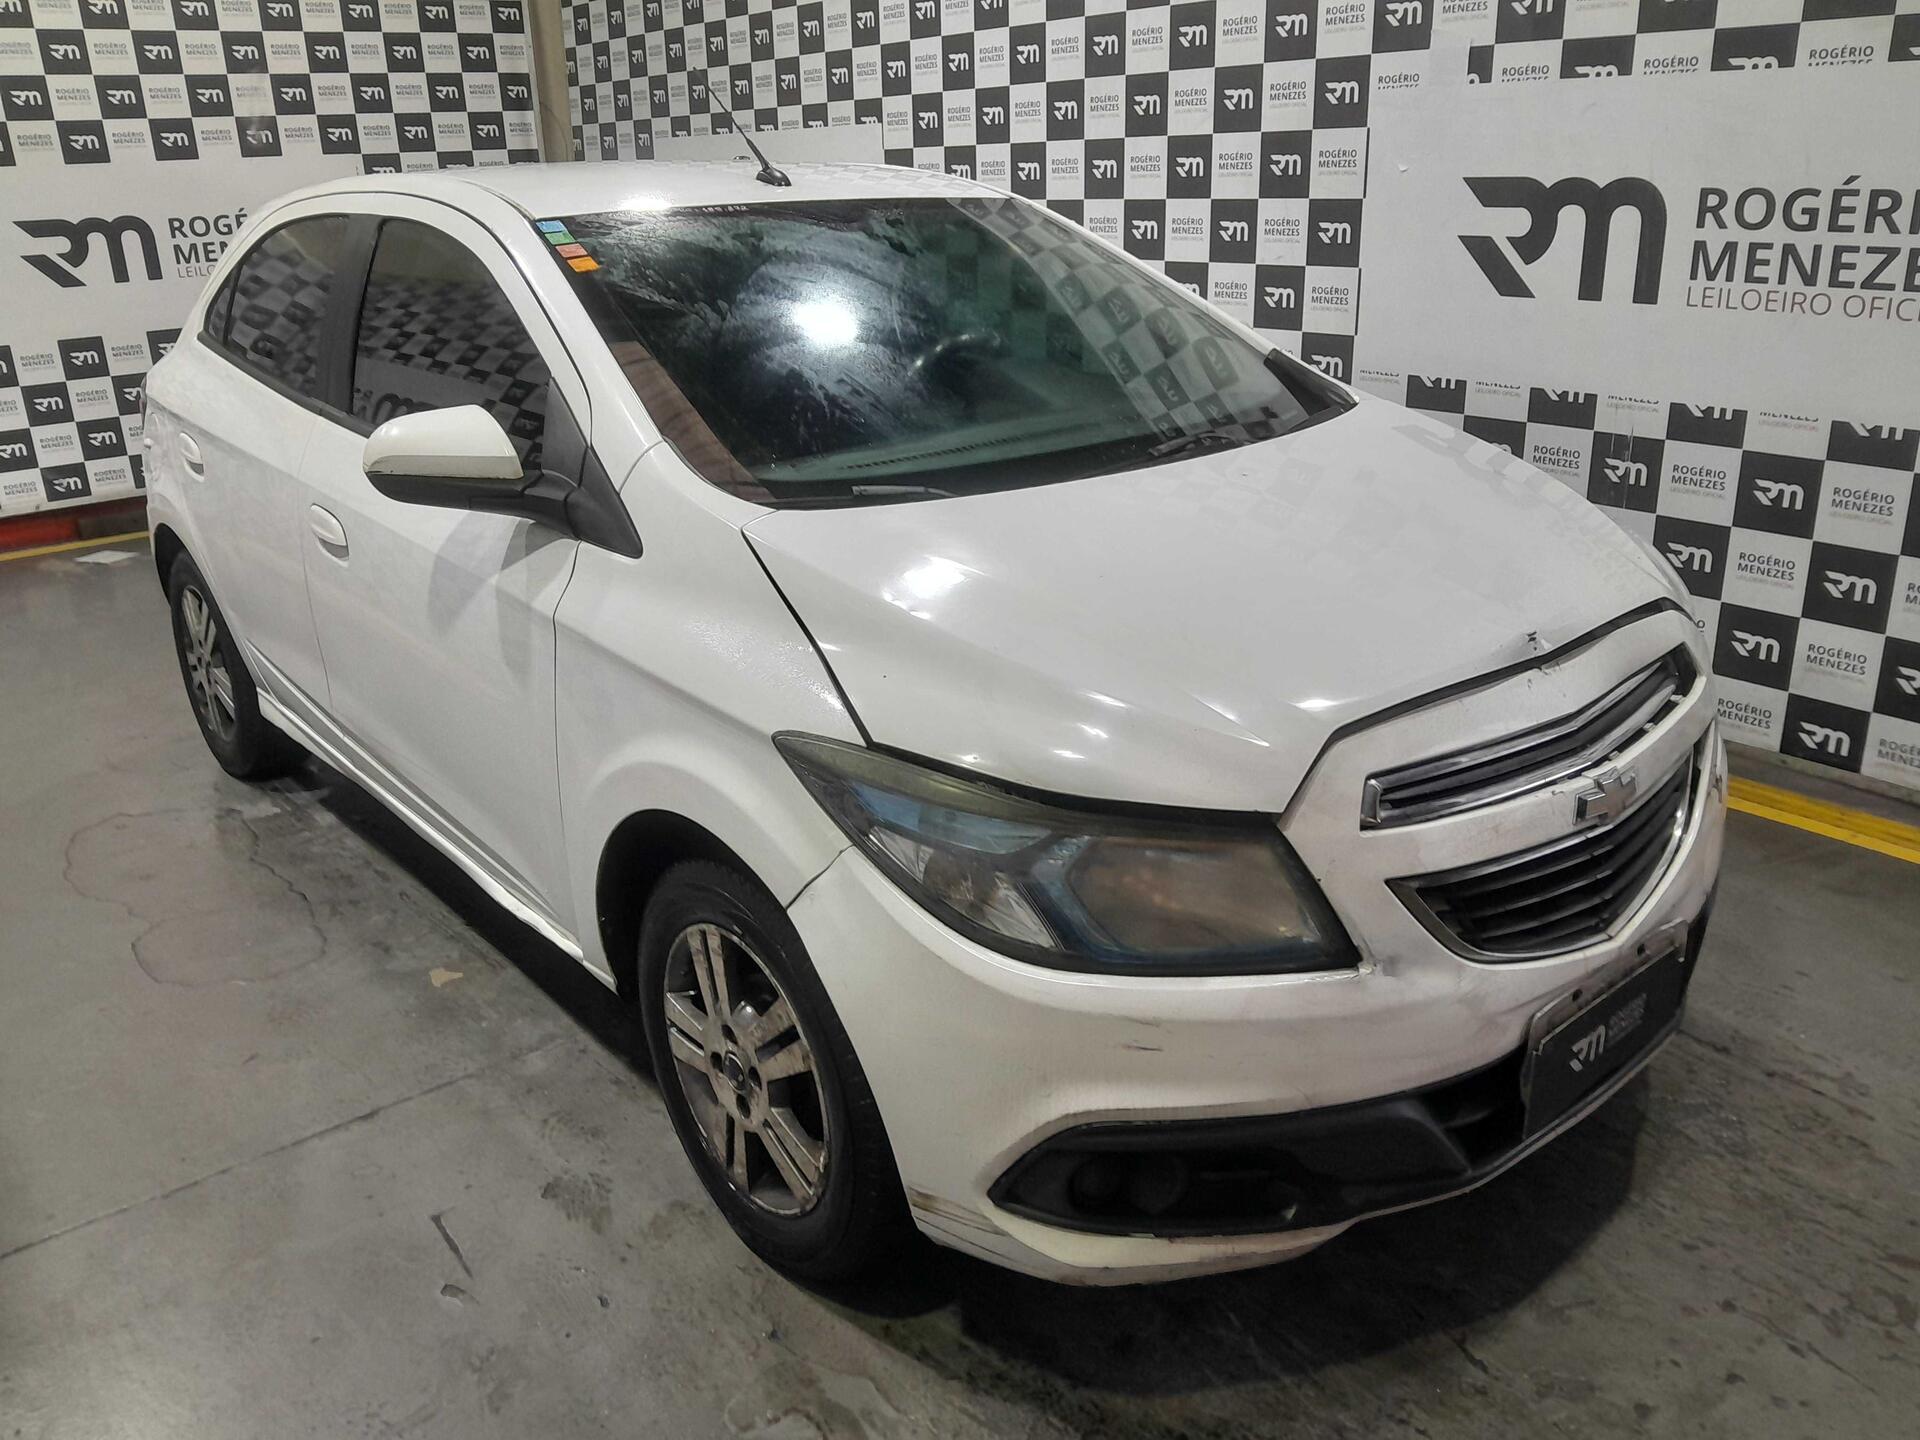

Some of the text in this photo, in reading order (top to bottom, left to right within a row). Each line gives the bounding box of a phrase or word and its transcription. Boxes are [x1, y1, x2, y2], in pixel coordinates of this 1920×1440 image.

[1325, 3, 1365, 16] ROGÉRIO
[1442, 2, 1488, 14] MENEZES
[1222, 15, 1258, 26] ROGÉRIO
[1325, 13, 1365, 26] MENEZES
[1131, 26, 1163, 37] ROGÉRIO
[1223, 24, 1258, 36] MENEZES
[1051, 35, 1079, 46] ROGÉRIO
[1132, 35, 1164, 46] MENEZES
[979, 45, 1004, 55] ROGÉRIO
[1051, 44, 1079, 56] MENEZES
[1808, 45, 1874, 61] ROGÉRIO
[979, 53, 1004, 63] MENEZES
[1643, 55, 1699, 70] ROGÉRIO
[1502, 65, 1550, 76] ROGÉRIO
[1378, 73, 1420, 84] ROGÉRIO
[1270, 80, 1307, 92] ROGÉRIO
[1174, 87, 1207, 97] ROGÉRIO
[1270, 90, 1307, 101] MENEZES
[1015, 100, 1041, 110] ROGÉRIO
[1090, 94, 1119, 105] ROGÉRIO
[1175, 96, 1207, 107] MENEZES
[1015, 108, 1041, 117] MENEZES
[1090, 102, 1120, 112] MENEZES
[1130, 154, 1161, 163] ROGÉRIO
[1219, 151, 1253, 161] ROGÉRIO
[1318, 148, 1357, 159] ROGÉRIO
[981, 160, 1006, 169] ROGÉRIO
[1052, 157, 1079, 167] ROGÉRIO
[1130, 162, 1161, 172] MENEZES
[1219, 160, 1253, 170] MENEZES
[1318, 157, 1357, 168] MENEZES
[981, 167, 1006, 176] MENEZES
[1052, 165, 1079, 174] MENEZES
[1696, 176, 1920, 235] ROGÉRI
[168, 208, 248, 239] ROGÉ
[1089, 216, 1118, 226] ROGÉRIO
[1172, 217, 1204, 225] ROGÉRIO
[1264, 217, 1300, 227] ROGÉRIO
[1089, 224, 1118, 234] MENEZES
[1172, 226, 1204, 234] MENEZES
[1264, 227, 1300, 236] MENEZES
[1690, 240, 1920, 292] MENEZE
[1214, 281, 1247, 291] ROGÉRIO
[1311, 285, 1349, 296] ROGÉRIO
[1214, 290, 1248, 299] MENEZES
[1311, 295, 1349, 305] MENEZES
[1686, 286, 1920, 322] LEILOEIRO OFIC
[1534, 445, 1580, 459] ROGÉRIO
[1532, 455, 1580, 469] MENEZES
[1672, 464, 1726, 480] ROGÉRIO
[1671, 475, 1726, 491] MENEZES
[1833, 487, 1895, 504] ROGÉRIO
[1832, 499, 1894, 516] MENEZES
[1739, 552, 1796, 570] ROGÉRIO
[1738, 562, 1795, 581] MENEZES
[1808, 644, 1868, 664] ROGÉRIO
[1807, 654, 1866, 675] MENEZES
[1718, 698, 1772, 719] ROGÉRIO
[1717, 708, 1771, 729] MENEZES
[1880, 739, 1920, 754] ROGÉ
